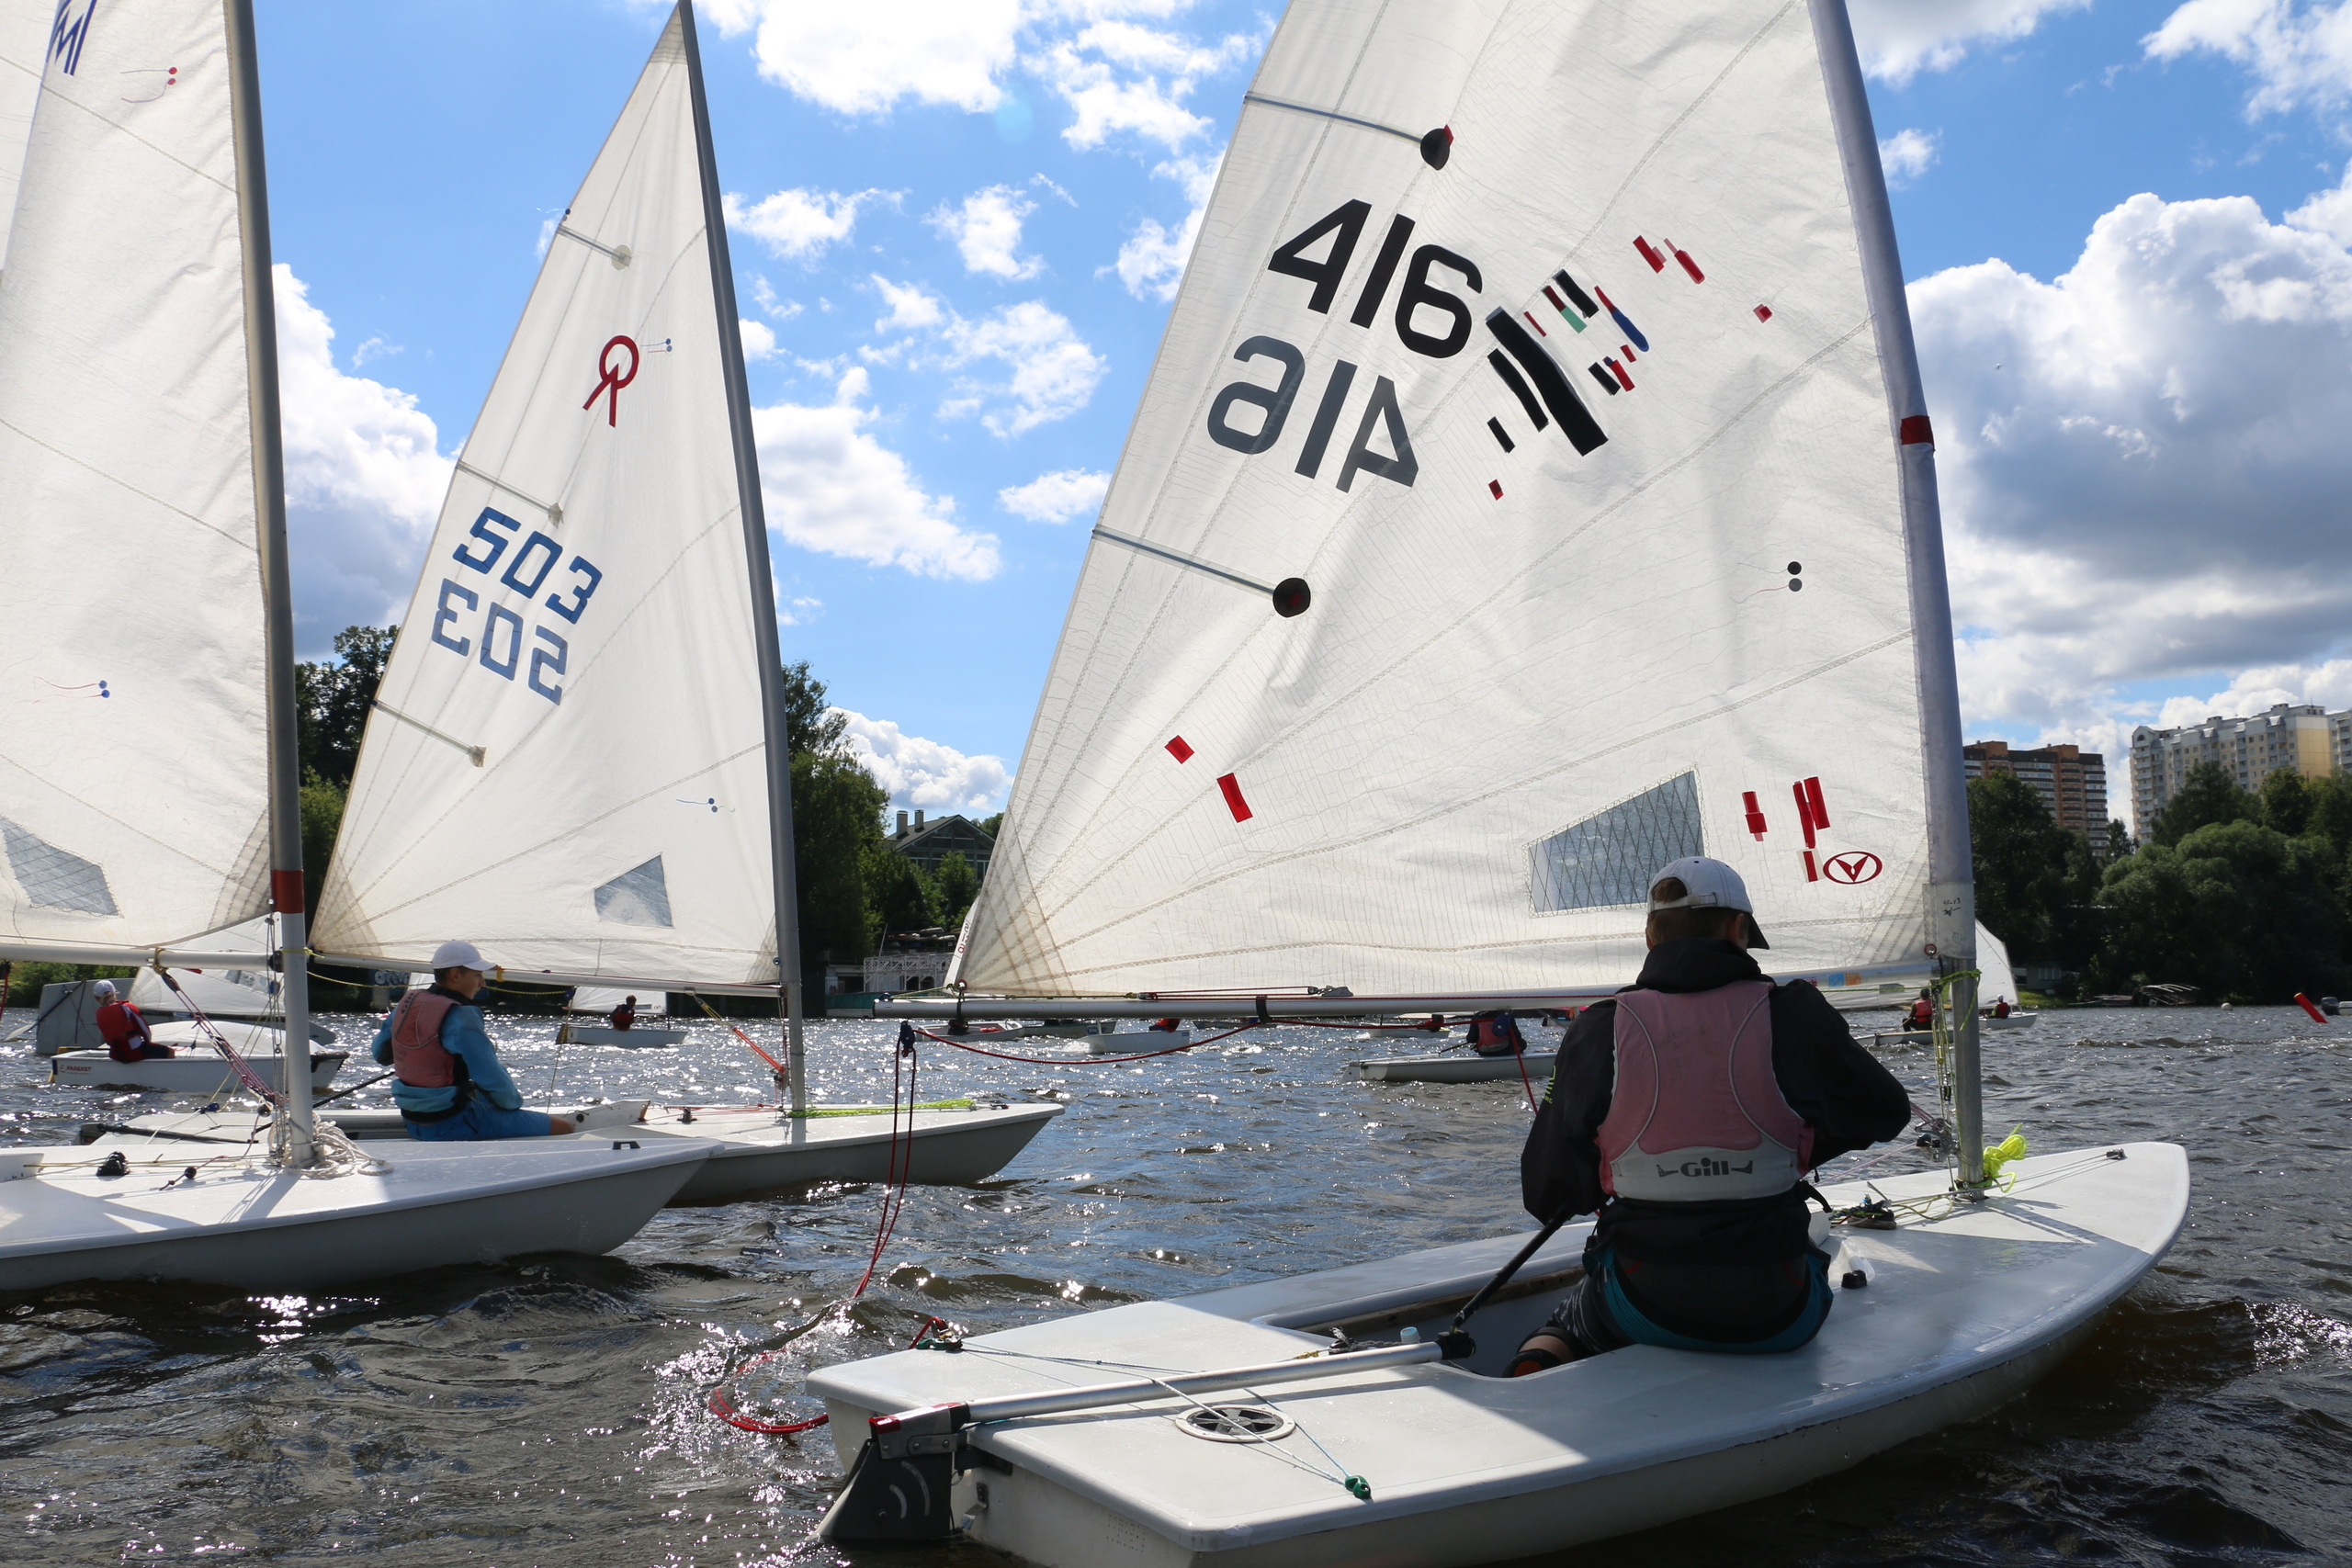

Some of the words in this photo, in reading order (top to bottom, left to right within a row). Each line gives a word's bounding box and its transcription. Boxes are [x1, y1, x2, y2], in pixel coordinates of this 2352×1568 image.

[1268, 198, 1482, 358] 416
[452, 506, 602, 624] 503
[1680, 1157, 1729, 1177] Gill
